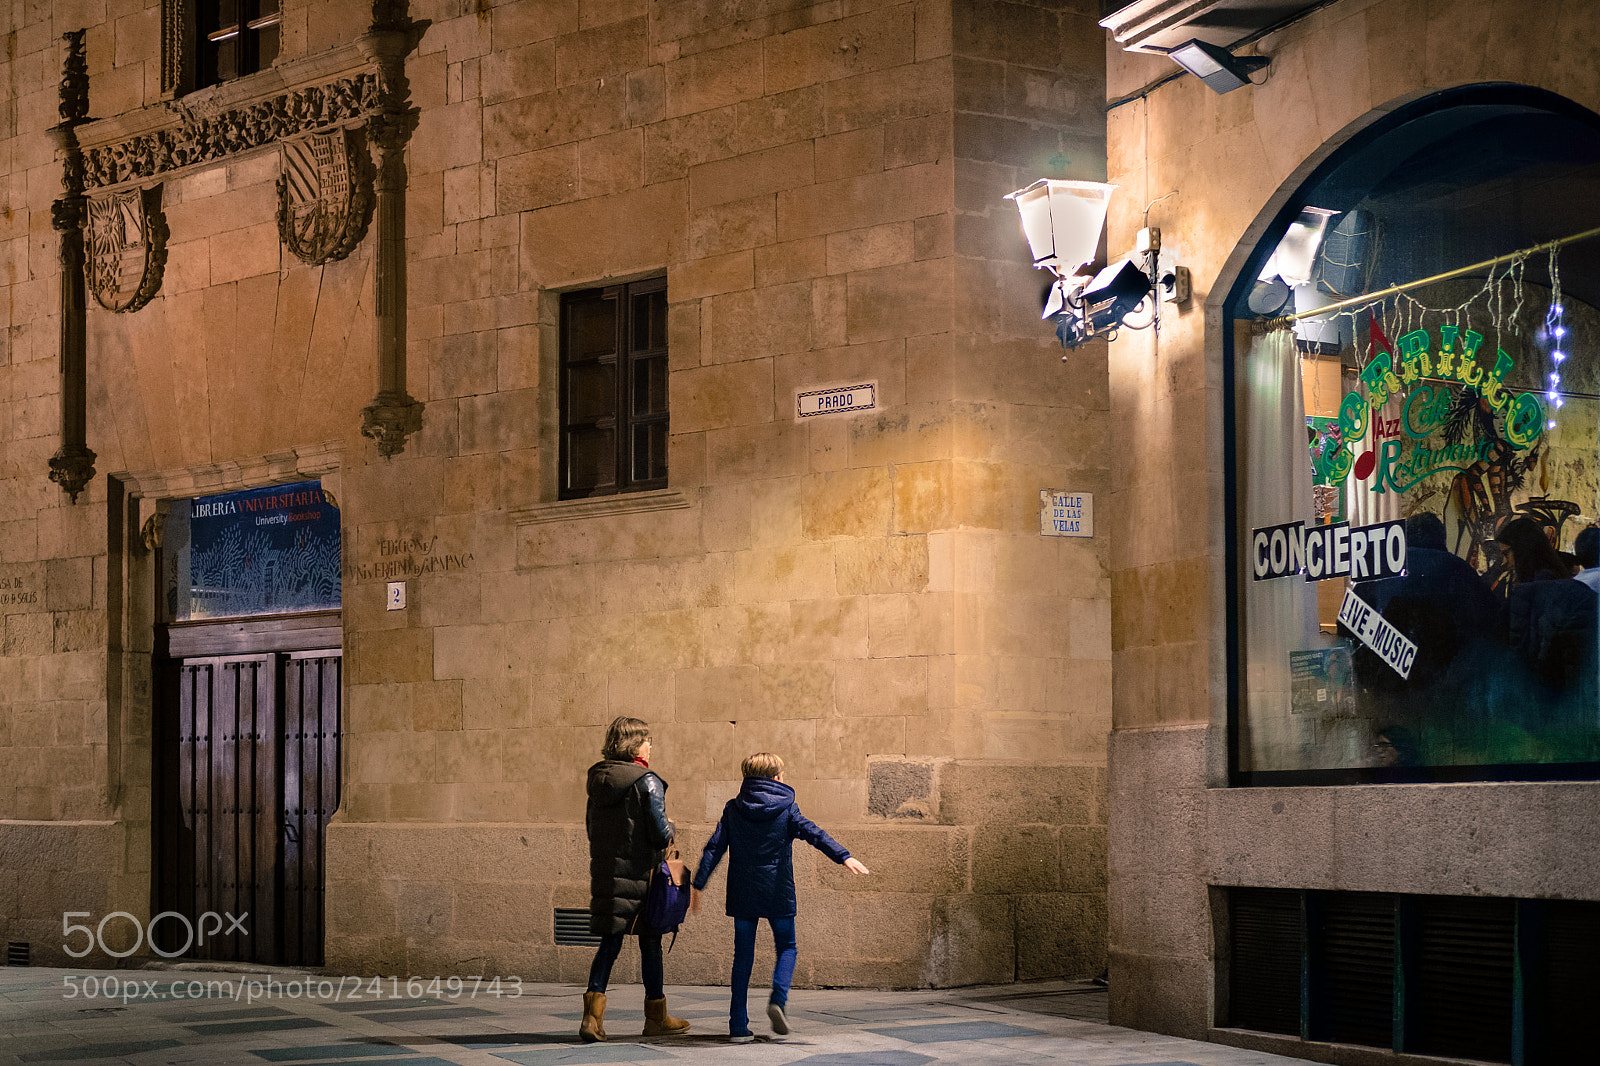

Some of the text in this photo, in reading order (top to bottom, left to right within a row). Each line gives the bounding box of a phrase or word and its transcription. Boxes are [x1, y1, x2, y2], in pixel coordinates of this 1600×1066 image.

[818, 393, 853, 410] PRADO
[1052, 496, 1082, 508] CALLE
[255, 510, 321, 526] University Bookshop
[1053, 509, 1082, 519] DE LAS
[1053, 519, 1080, 532] VELAS
[1253, 524, 1406, 579] CONCIERTO
[393, 588, 400, 603] 2
